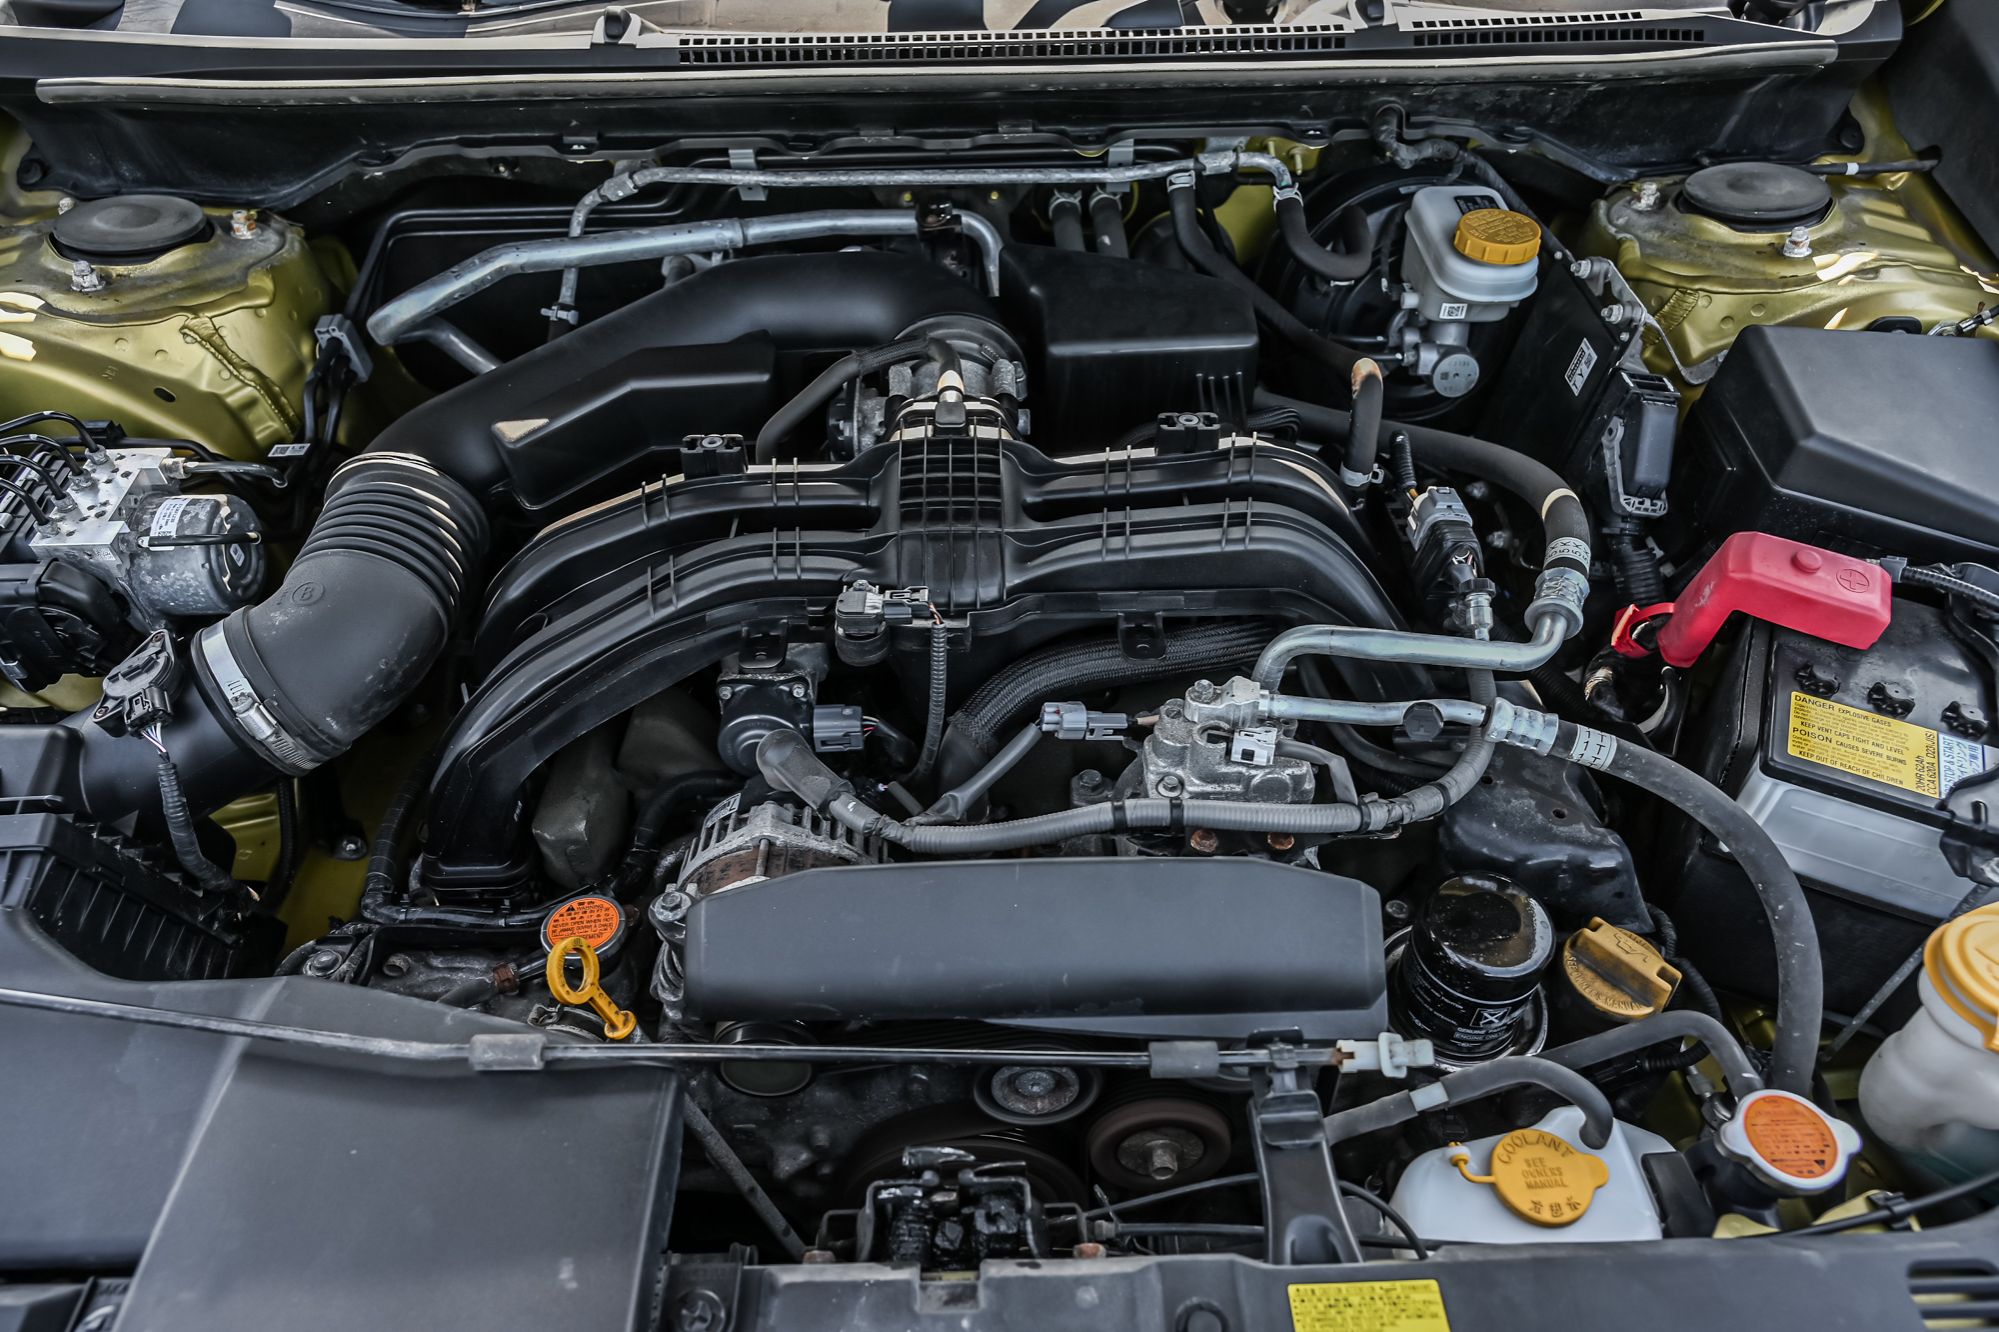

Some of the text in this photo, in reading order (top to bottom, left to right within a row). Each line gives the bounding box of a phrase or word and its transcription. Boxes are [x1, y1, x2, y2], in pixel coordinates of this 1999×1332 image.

[1794, 694, 1892, 727] DANGER EXPLOSIVE GASES
[1792, 727, 1907, 766] POISON CAUSES SEVERE BURNS
[1800, 721, 1904, 755] KEEP VENT CAPS TIGHT AND LEVEL
[1943, 737, 1954, 760] START
[1798, 750, 1813, 759] KEEP
[1815, 754, 1828, 763] OUT
[1840, 762, 1861, 772] REACH
[1862, 767, 1871, 775] OF
[1872, 771, 1904, 785] CHILDREN
[1943, 767, 1955, 783] STOP
[1926, 780, 1937, 795] CCA
[1497, 1131, 1575, 1165] COOLANT
[1523, 1156, 1548, 1169] SEE
[1523, 1178, 1569, 1191] MANUAL
